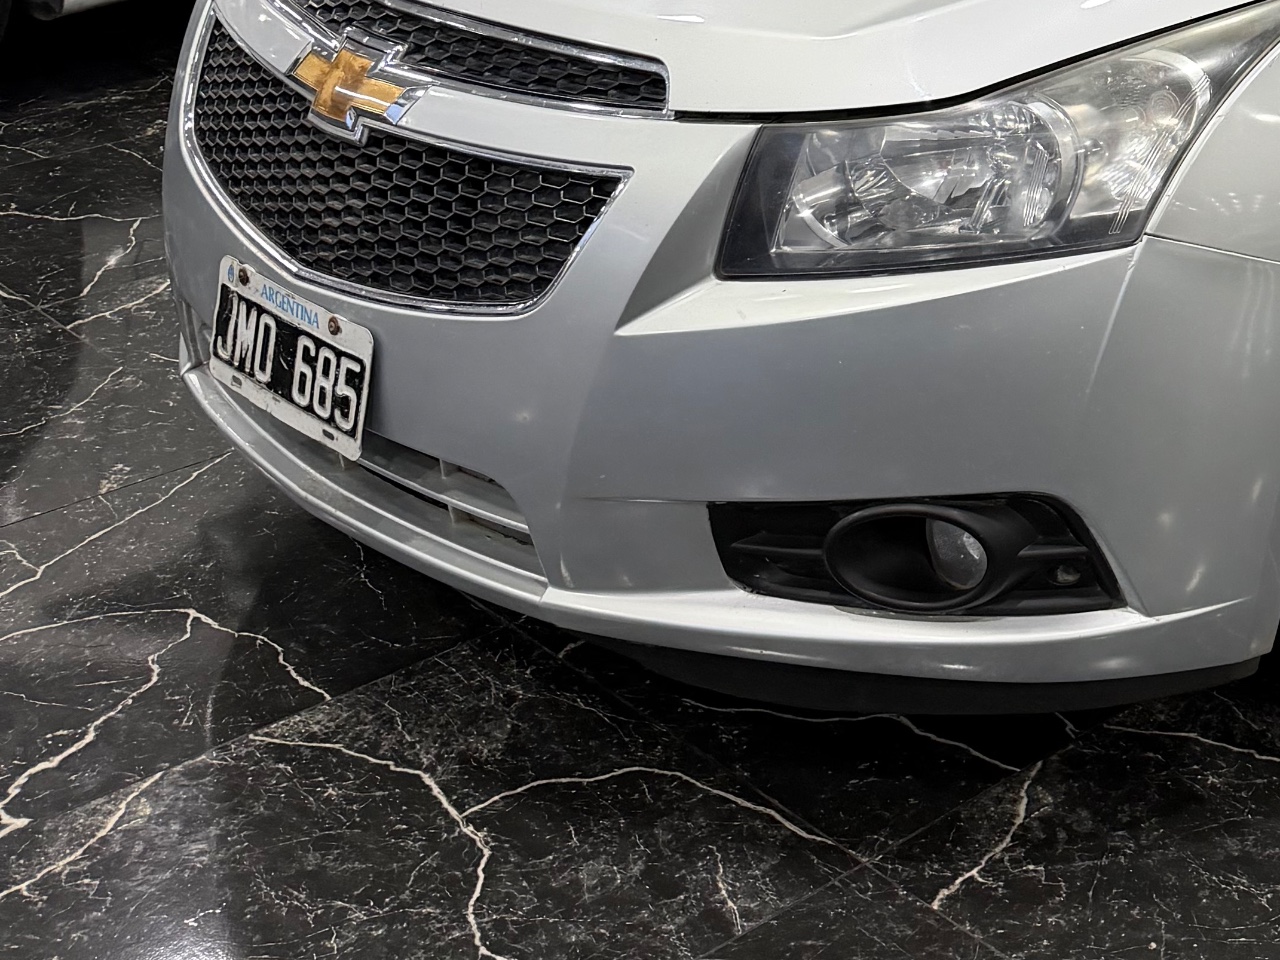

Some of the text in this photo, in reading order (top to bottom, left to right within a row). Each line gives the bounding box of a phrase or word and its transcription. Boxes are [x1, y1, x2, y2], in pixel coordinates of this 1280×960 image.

[261, 284, 319, 329] ARGENTINA
[217, 292, 361, 431] JMO 685
